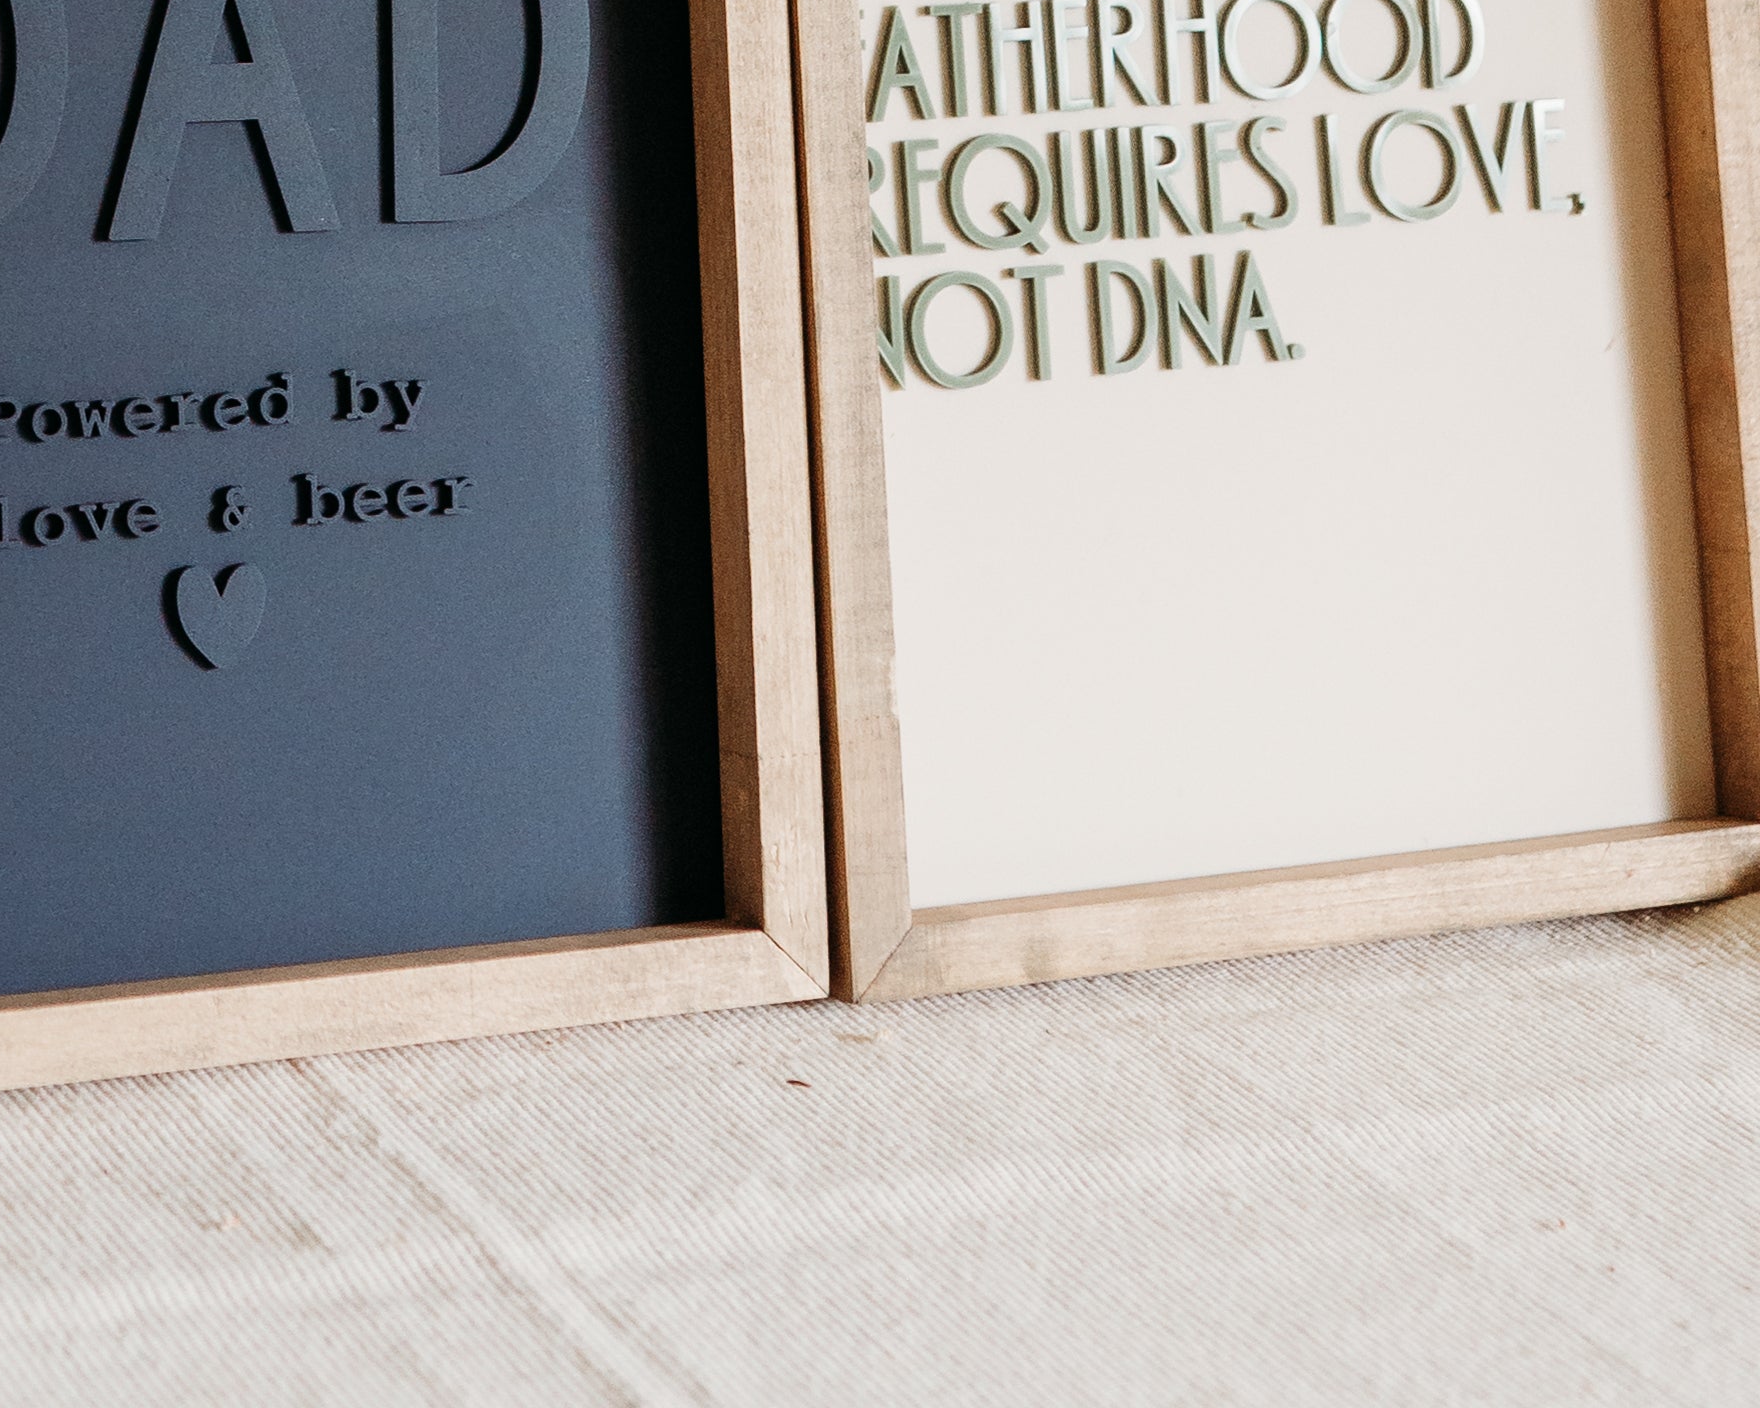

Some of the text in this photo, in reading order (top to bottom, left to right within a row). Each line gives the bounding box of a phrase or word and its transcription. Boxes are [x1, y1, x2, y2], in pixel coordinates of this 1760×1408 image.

[1314, 98, 1586, 227] LOVE,
[1086, 250, 1306, 377] DNA.
[332, 368, 428, 431] by
[209, 485, 251, 532] &
[292, 474, 476, 525] beer
